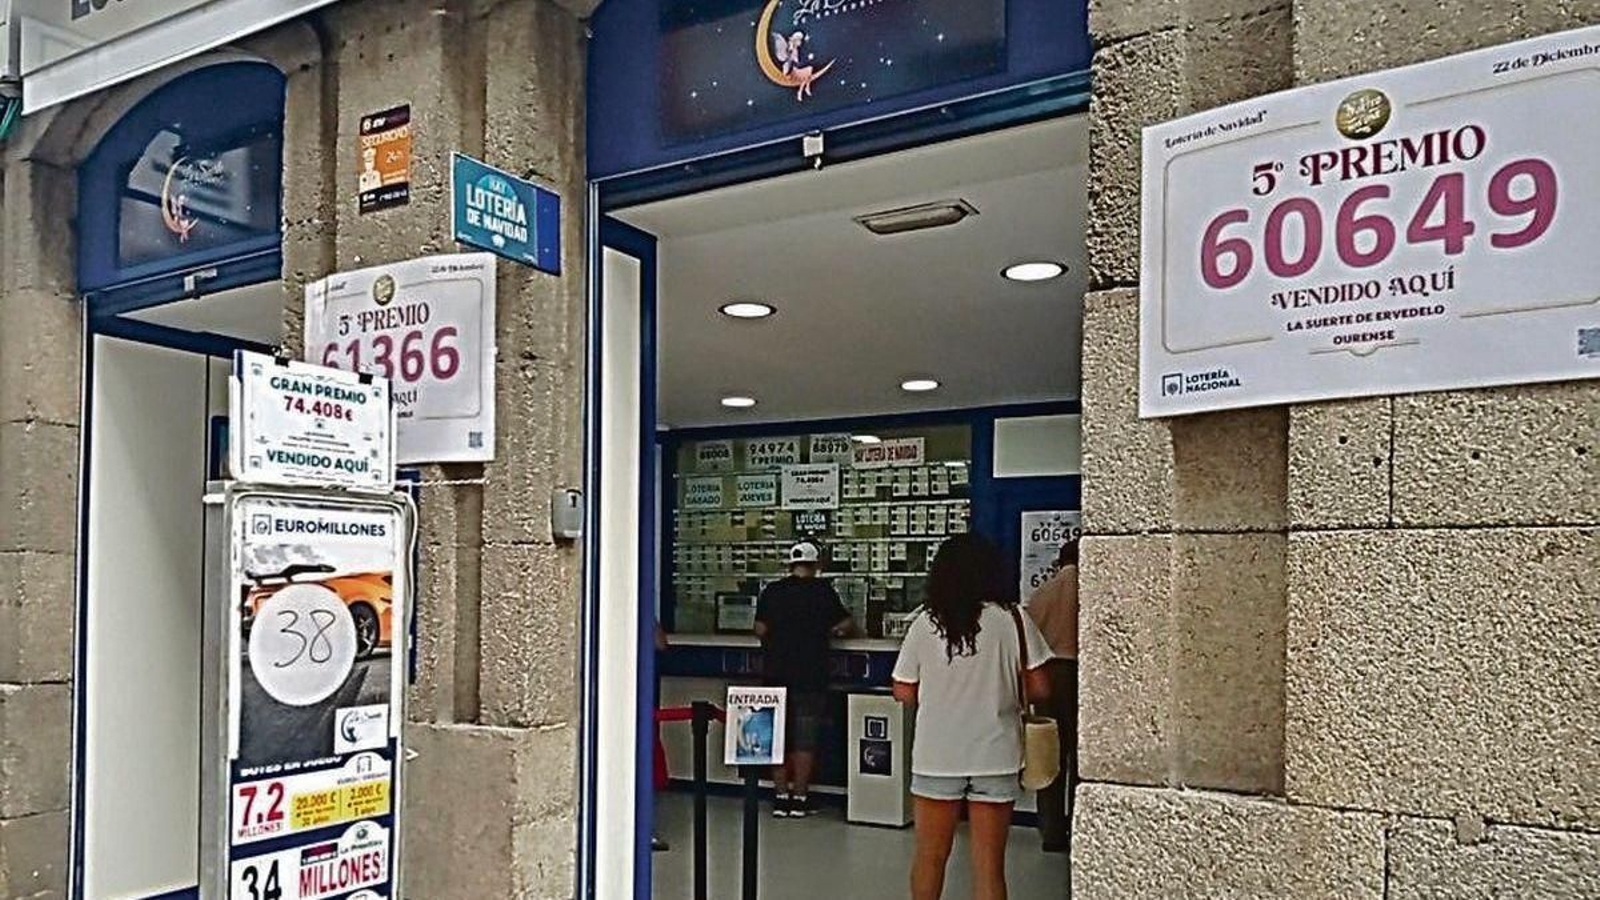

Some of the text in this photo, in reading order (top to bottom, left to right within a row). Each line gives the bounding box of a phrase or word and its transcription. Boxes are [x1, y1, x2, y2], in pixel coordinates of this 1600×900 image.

[1493, 62, 1510, 74] 22
[1512, 58, 1529, 69] de
[1204, 126, 1217, 136] de
[1300, 125, 1486, 186] PREMIO
[466, 183, 528, 227] LOTERÍA
[466, 206, 528, 243] DE NAVIDAD
[1200, 158, 1559, 290] 60649
[1271, 265, 1454, 310] VENDIDO AQUÍ
[357, 302, 430, 333] PREMIO
[1287, 304, 1446, 332] LA SUERTE DE ERVEDELO
[1333, 330, 1395, 346] OURENSE
[270, 376, 367, 404] GRAN PREMIO
[1186, 378, 1242, 394] NACIONAL
[267, 449, 370, 474] VENDIDO AQUÍ
[275, 519, 386, 537] EUROMILLONES
[274, 609, 336, 668] 38
[729, 694, 779, 704] ENTRADA
[239, 782, 284, 826] 7.2
[238, 822, 282, 838] MILLONES
[242, 859, 282, 900] 34
[300, 851, 381, 898] MILLONES
